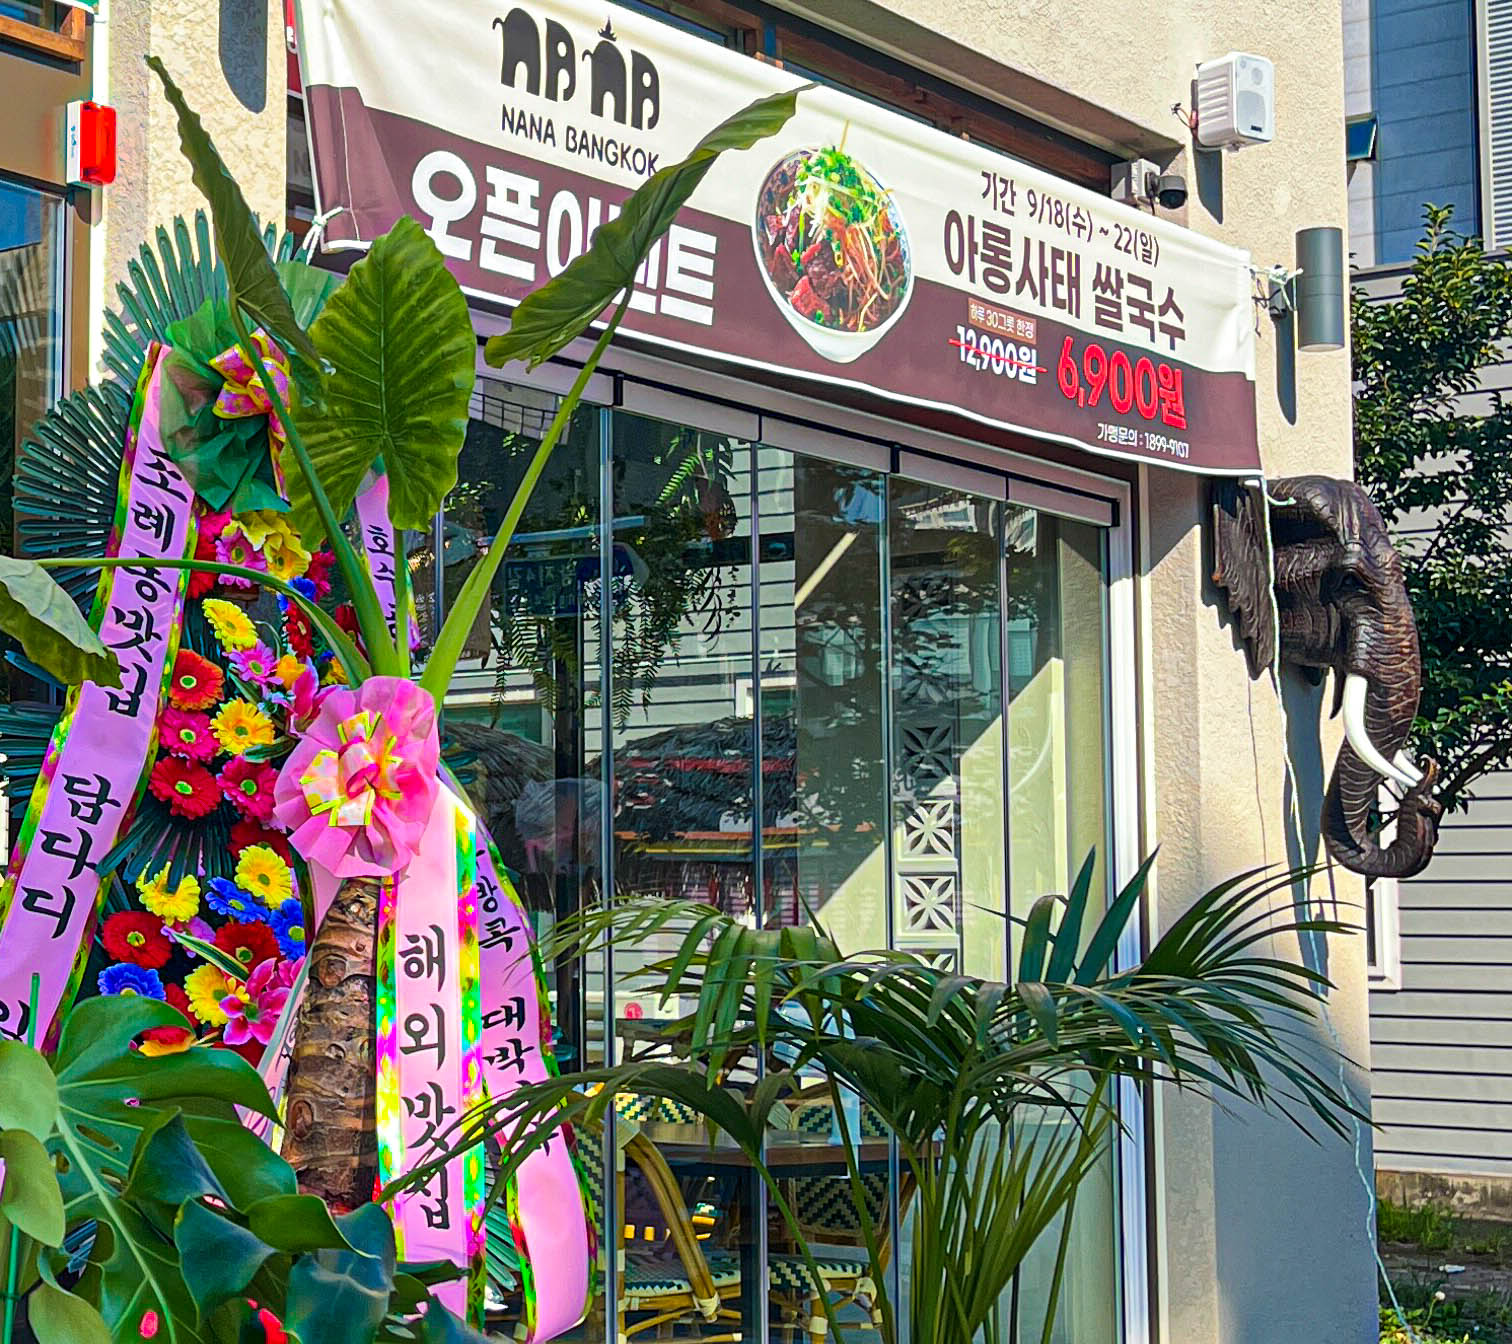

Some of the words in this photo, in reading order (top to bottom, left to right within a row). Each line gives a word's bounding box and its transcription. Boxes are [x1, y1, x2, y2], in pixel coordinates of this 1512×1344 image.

[501, 104, 557, 148] NANA
[565, 124, 660, 178] BANGKOK
[979, 170, 1018, 218] 기간
[1026, 187, 1094, 245] 9/18(수)
[1114, 222, 1161, 269] 22(일)
[942, 209, 1082, 319] 아롱사태
[1091, 259, 1187, 352] 쌀국수
[956, 324, 1038, 385] 12,900원
[1057, 335, 1188, 431] 6,900원
